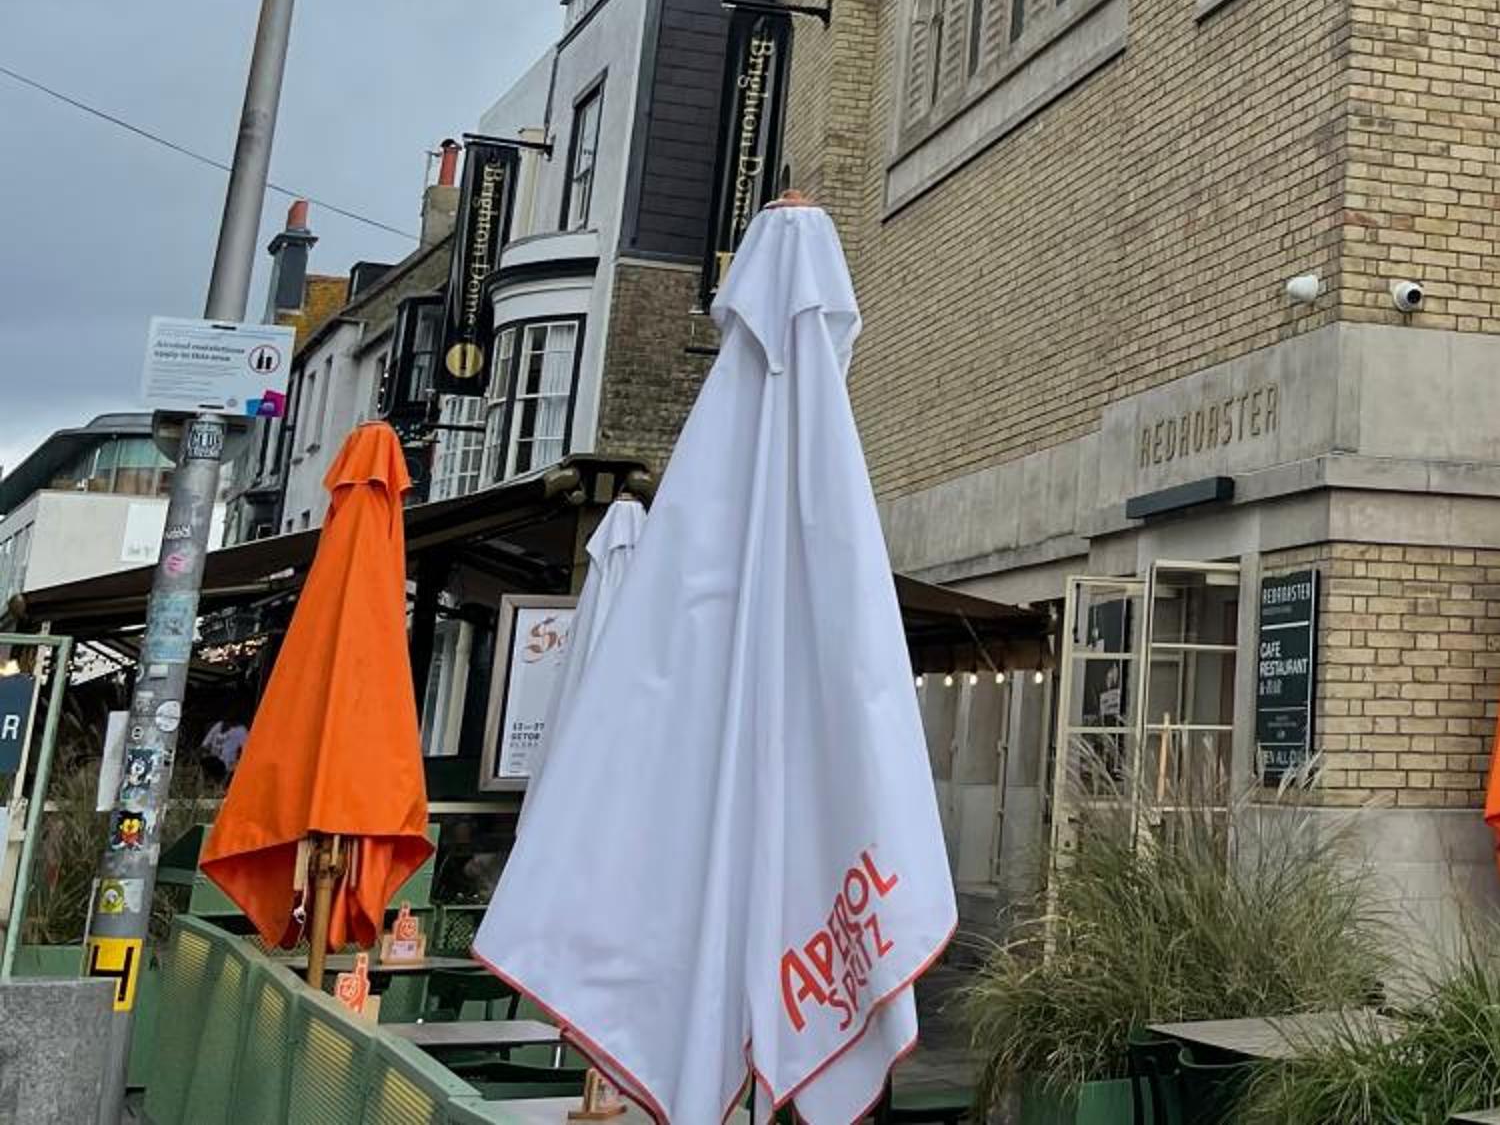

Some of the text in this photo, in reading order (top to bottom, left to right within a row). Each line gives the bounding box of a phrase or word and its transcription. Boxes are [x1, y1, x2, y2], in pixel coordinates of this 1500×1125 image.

[738, 36, 774, 147] Brighton
[472, 163, 503, 255] Brighton
[1140, 382, 1279, 468] REDROASTER
[1263, 582, 1311, 604] REDROASTER
[1260, 641, 1281, 658] CAFE
[1260, 659, 1309, 677] RESTAURANT
[781, 851, 898, 1033] APEROL
